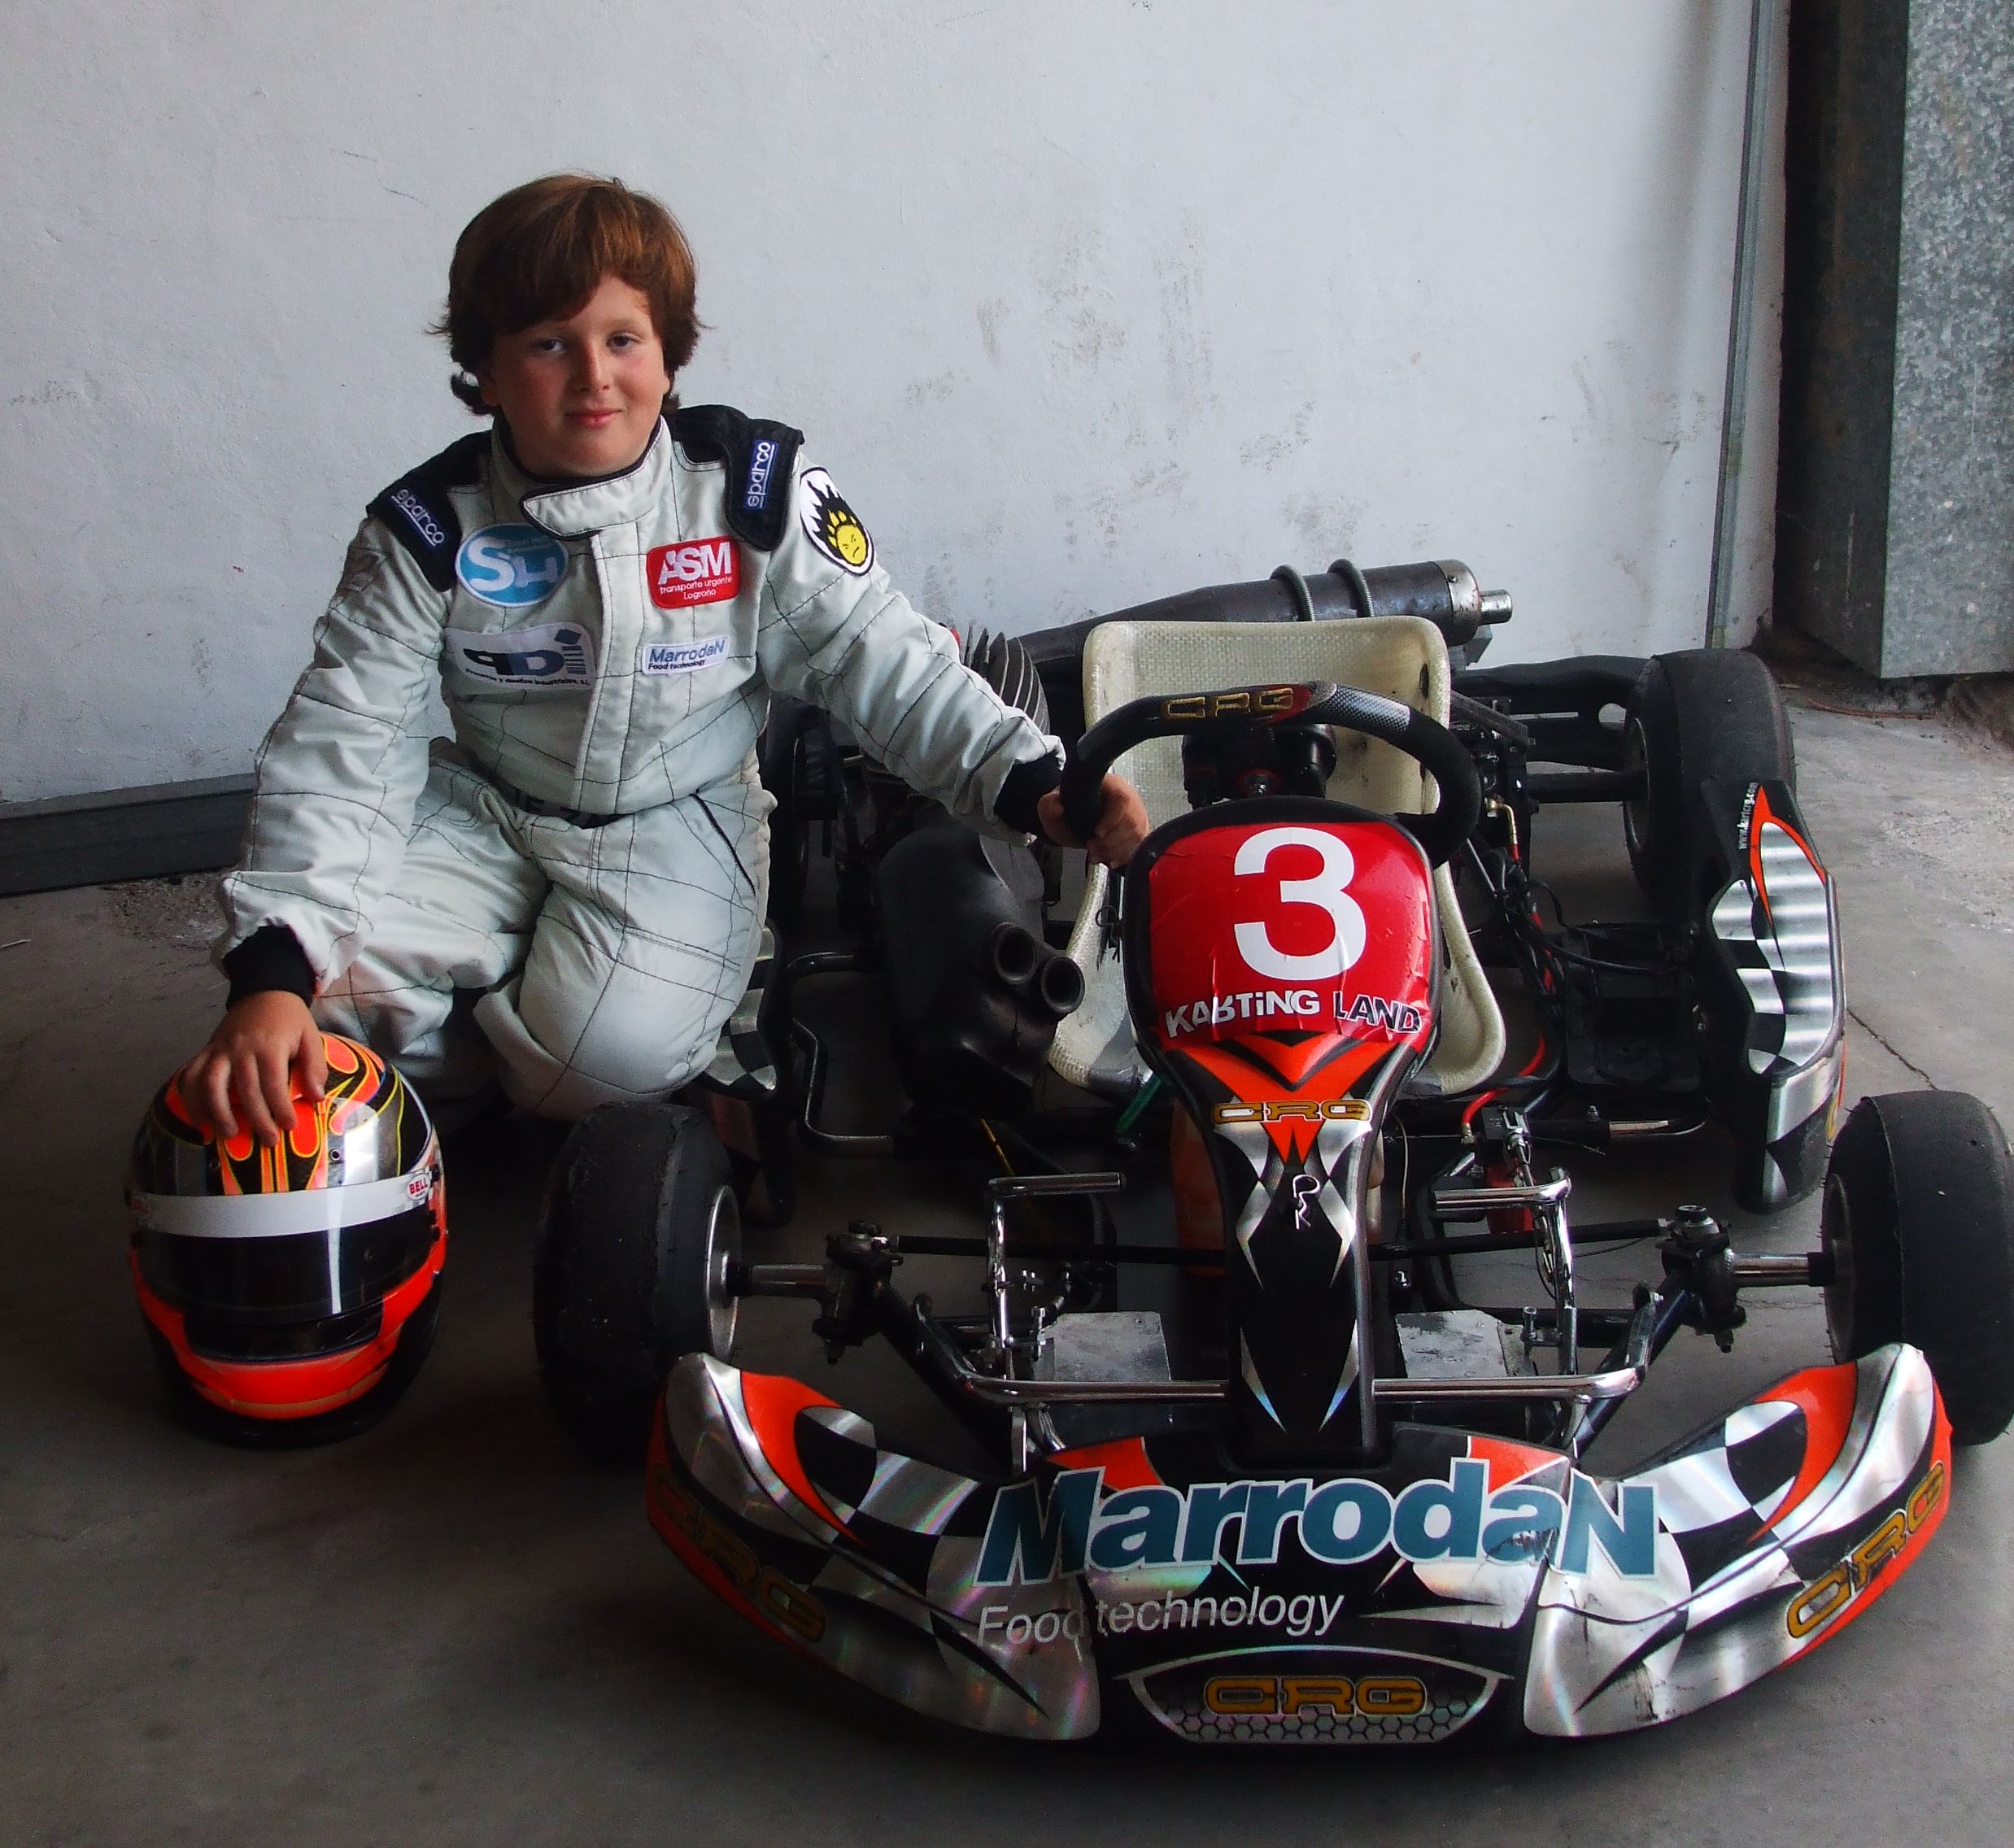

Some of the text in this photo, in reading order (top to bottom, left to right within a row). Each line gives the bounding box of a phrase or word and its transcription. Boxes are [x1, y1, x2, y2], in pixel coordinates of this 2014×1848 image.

[748, 442, 773, 507] sparco
[395, 490, 445, 545] sparco
[657, 541, 733, 586] ASM
[660, 577, 732, 595] transporte urgente
[649, 639, 726, 663] MarrodaN
[1233, 826, 1367, 981] 3
[1332, 991, 1422, 1035] LAND
[1211, 1098, 1374, 1126] CRG
[409, 1177, 429, 1195] BELL
[1786, 1461, 1946, 1639] CRG
[1096, 1587, 1346, 1637] technology
[1203, 1676, 1429, 1716] CRG
